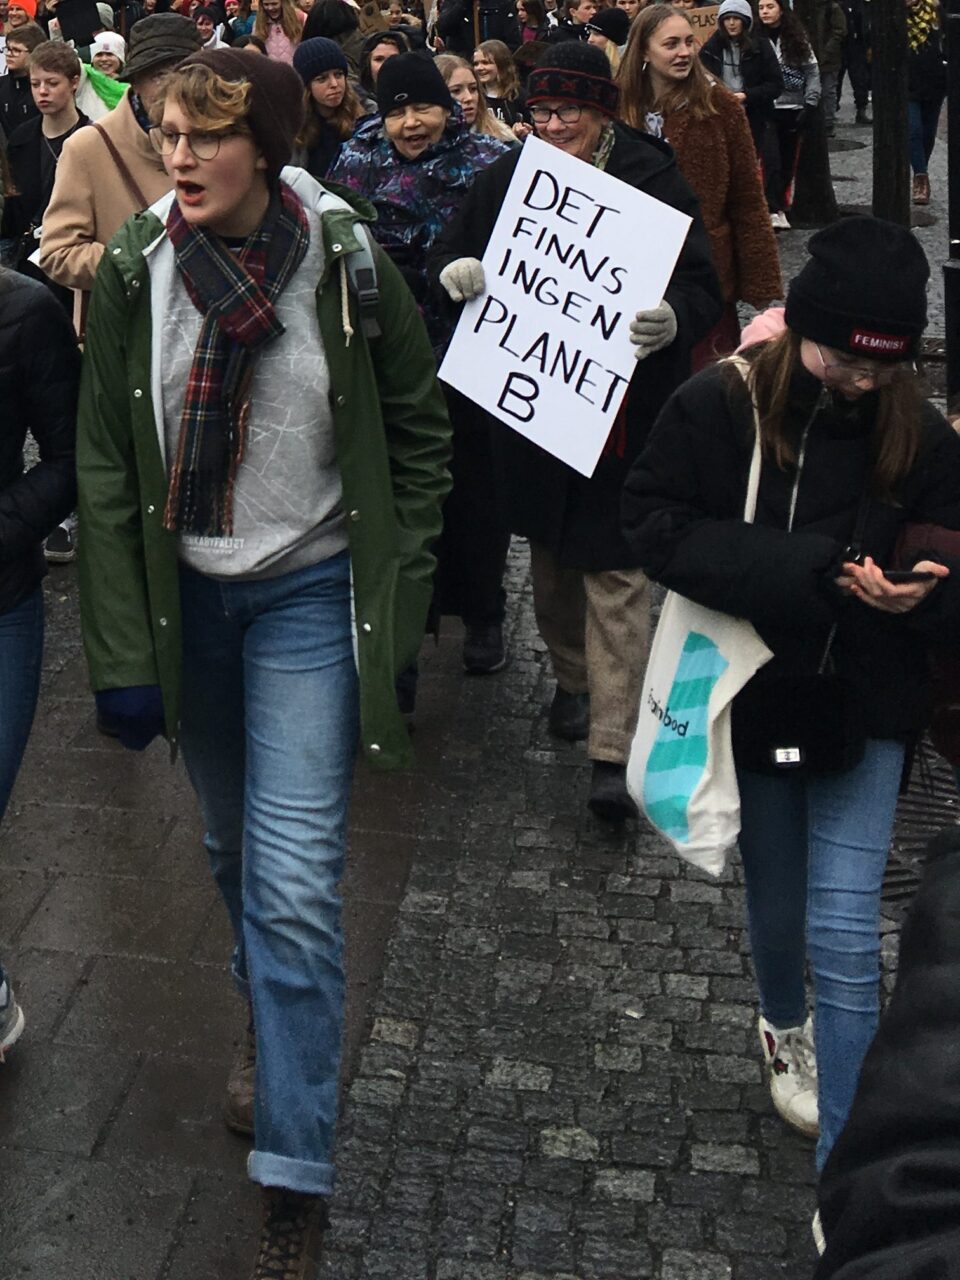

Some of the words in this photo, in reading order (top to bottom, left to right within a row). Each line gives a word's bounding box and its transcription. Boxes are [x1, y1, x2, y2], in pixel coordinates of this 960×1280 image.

[522, 169, 621, 239] DET
[498, 248, 622, 341] INGEN
[512, 216, 628, 295] FINNS
[473, 295, 630, 413] PLANET
[496, 371, 540, 423] B
